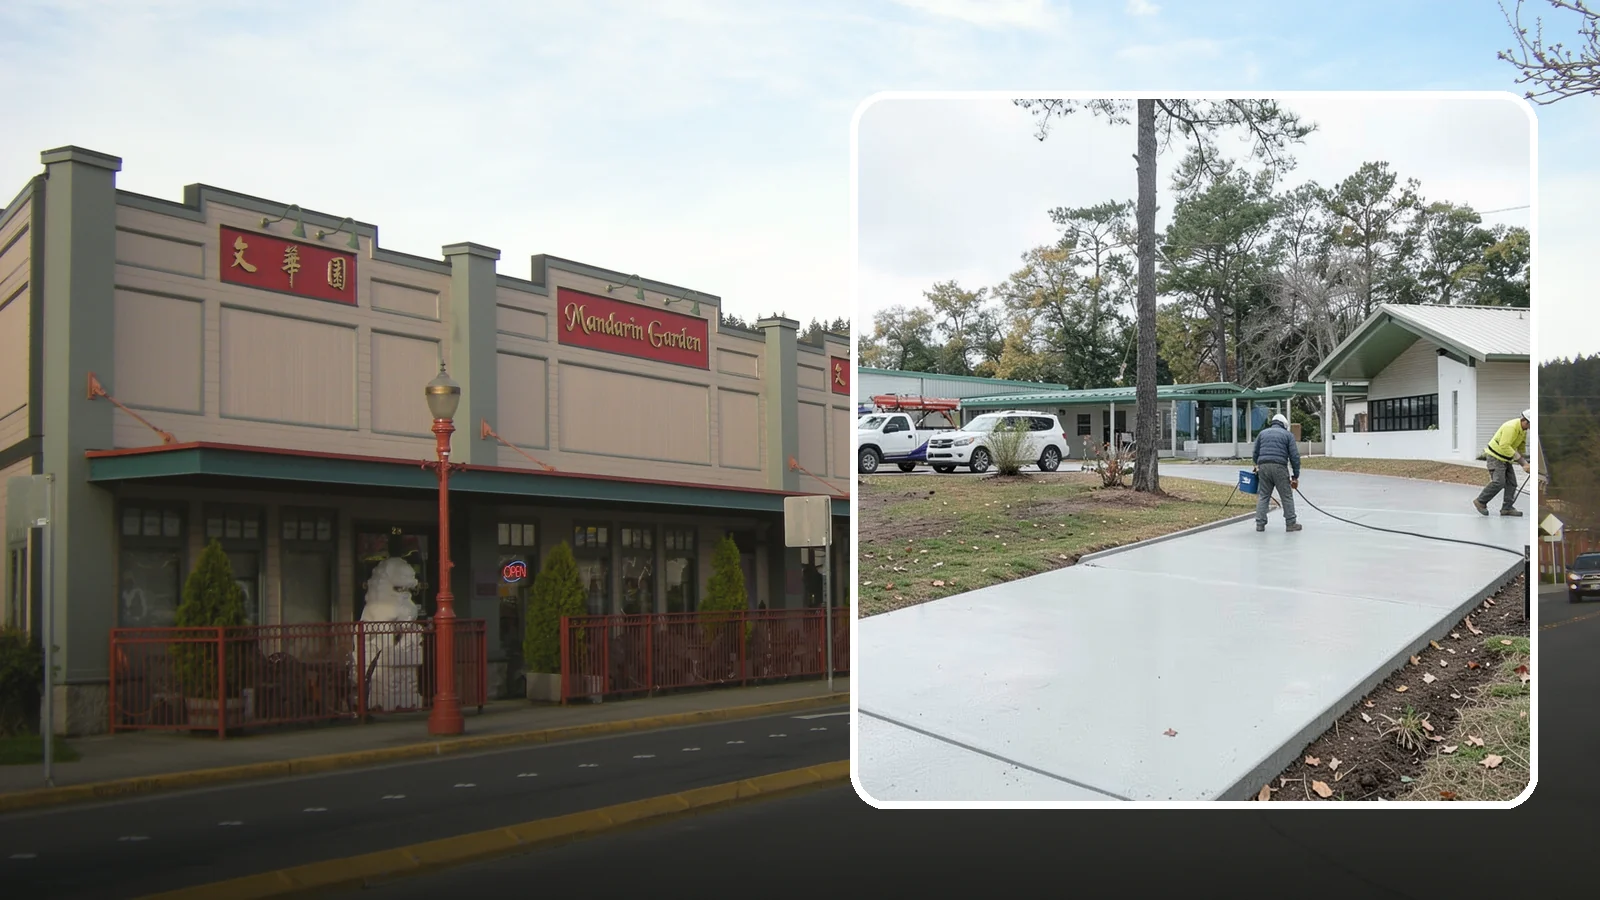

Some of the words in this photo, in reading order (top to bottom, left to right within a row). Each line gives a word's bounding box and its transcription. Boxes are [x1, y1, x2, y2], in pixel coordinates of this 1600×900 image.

[231, 235, 346, 291] 文華園
[564, 302, 644, 341] Mandarin
[648, 320, 701, 352] Garden
[503, 565, 527, 578] OPEN
